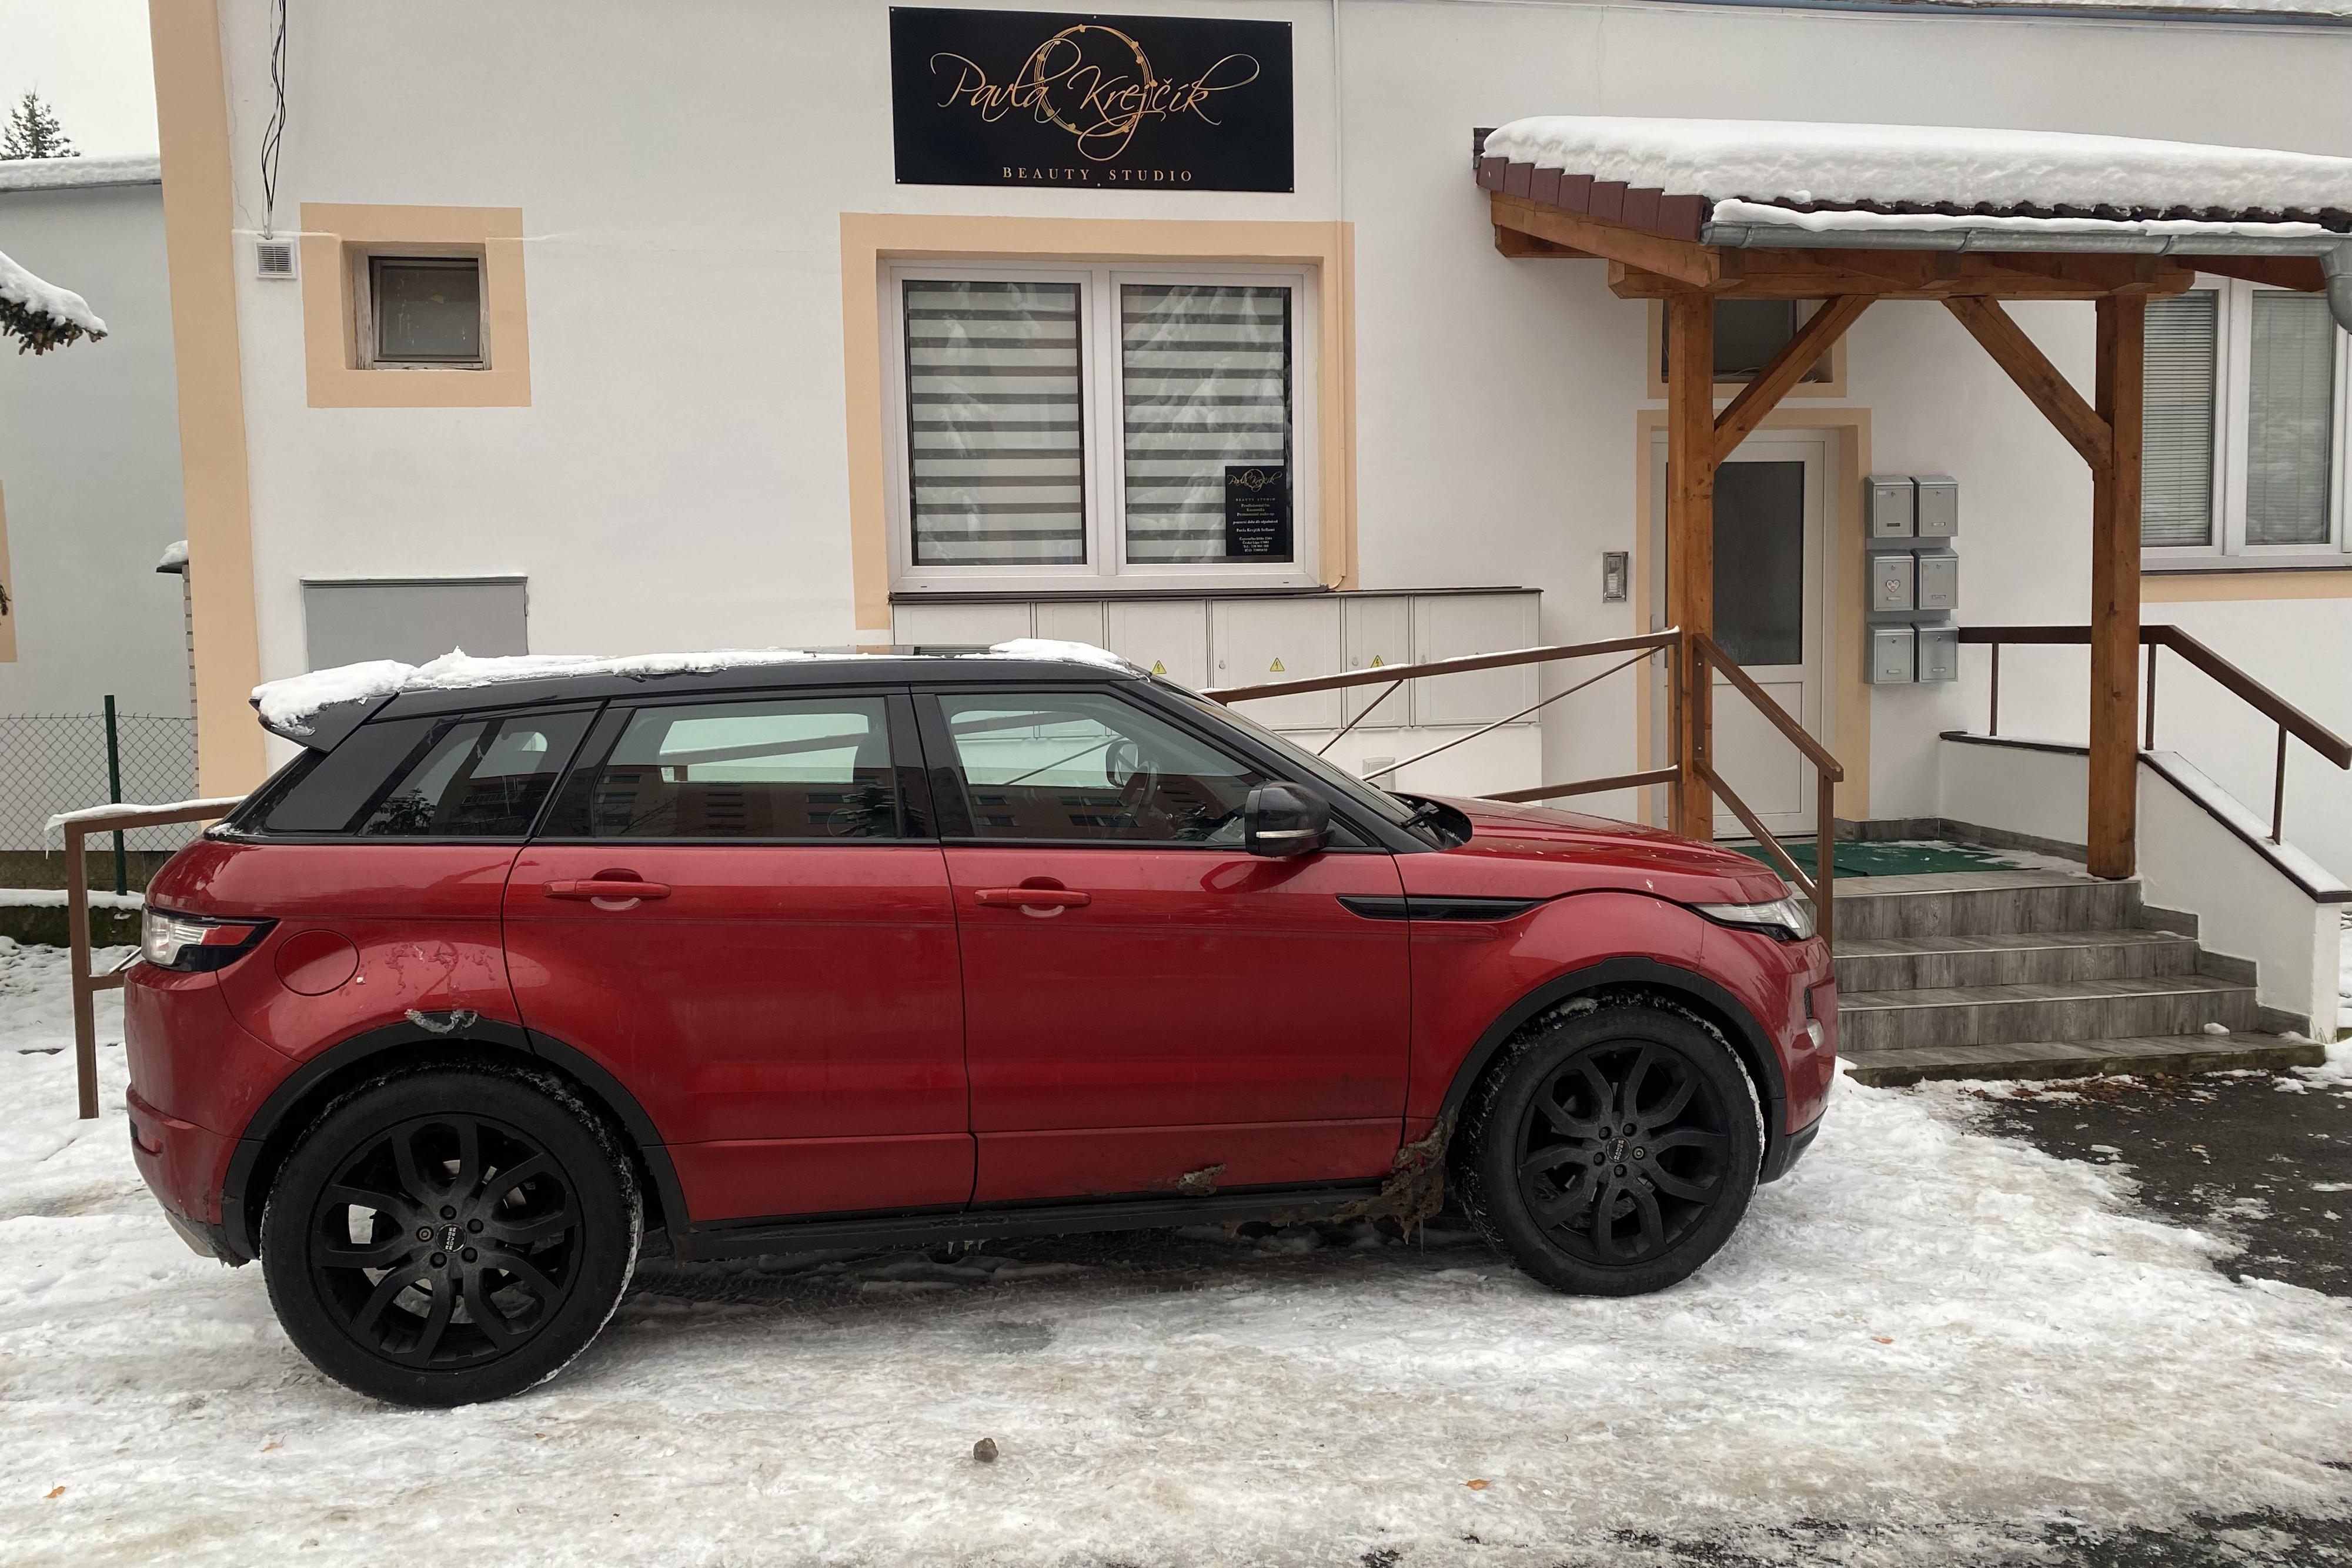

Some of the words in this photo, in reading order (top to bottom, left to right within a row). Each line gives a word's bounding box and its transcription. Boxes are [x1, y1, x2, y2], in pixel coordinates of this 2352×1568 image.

[930, 38, 1081, 123] Pavla
[1067, 53, 1259, 162] Krejčík
[1003, 166, 1091, 180] BEAUTY
[1108, 168, 1193, 182] STUDIO
[445, 1227, 453, 1249] RANGE
[449, 1227, 457, 1250] ROVER
